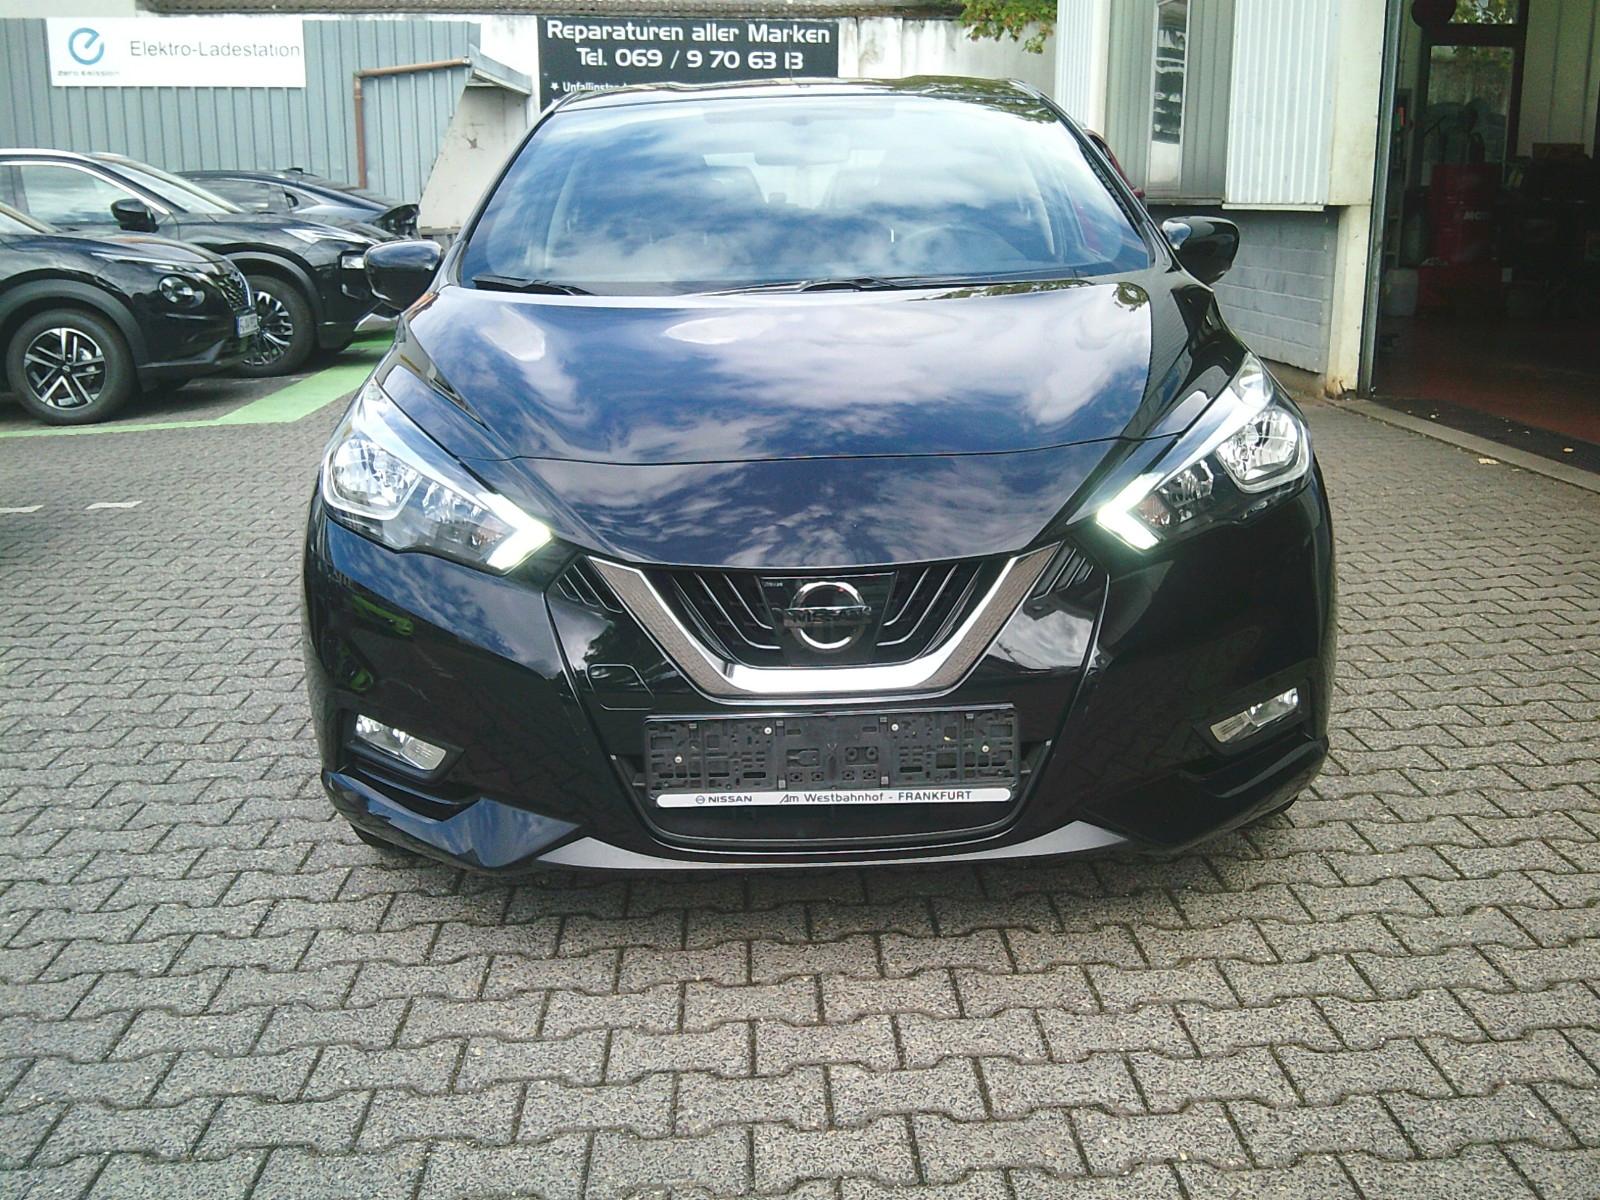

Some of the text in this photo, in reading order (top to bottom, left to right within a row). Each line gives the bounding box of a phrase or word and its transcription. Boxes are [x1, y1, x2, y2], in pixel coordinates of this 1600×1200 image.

[546, 19, 831, 44] Reparaturen aller Marken
[130, 40, 301, 57] Elektro-Ladestation
[576, 48, 804, 70] Tel. 069 / 9 70 63 13
[708, 795, 753, 804] NISSAN
[779, 793, 800, 804] Am
[804, 791, 884, 803] Westbahnhof
[898, 790, 973, 802] FRANKFURT
